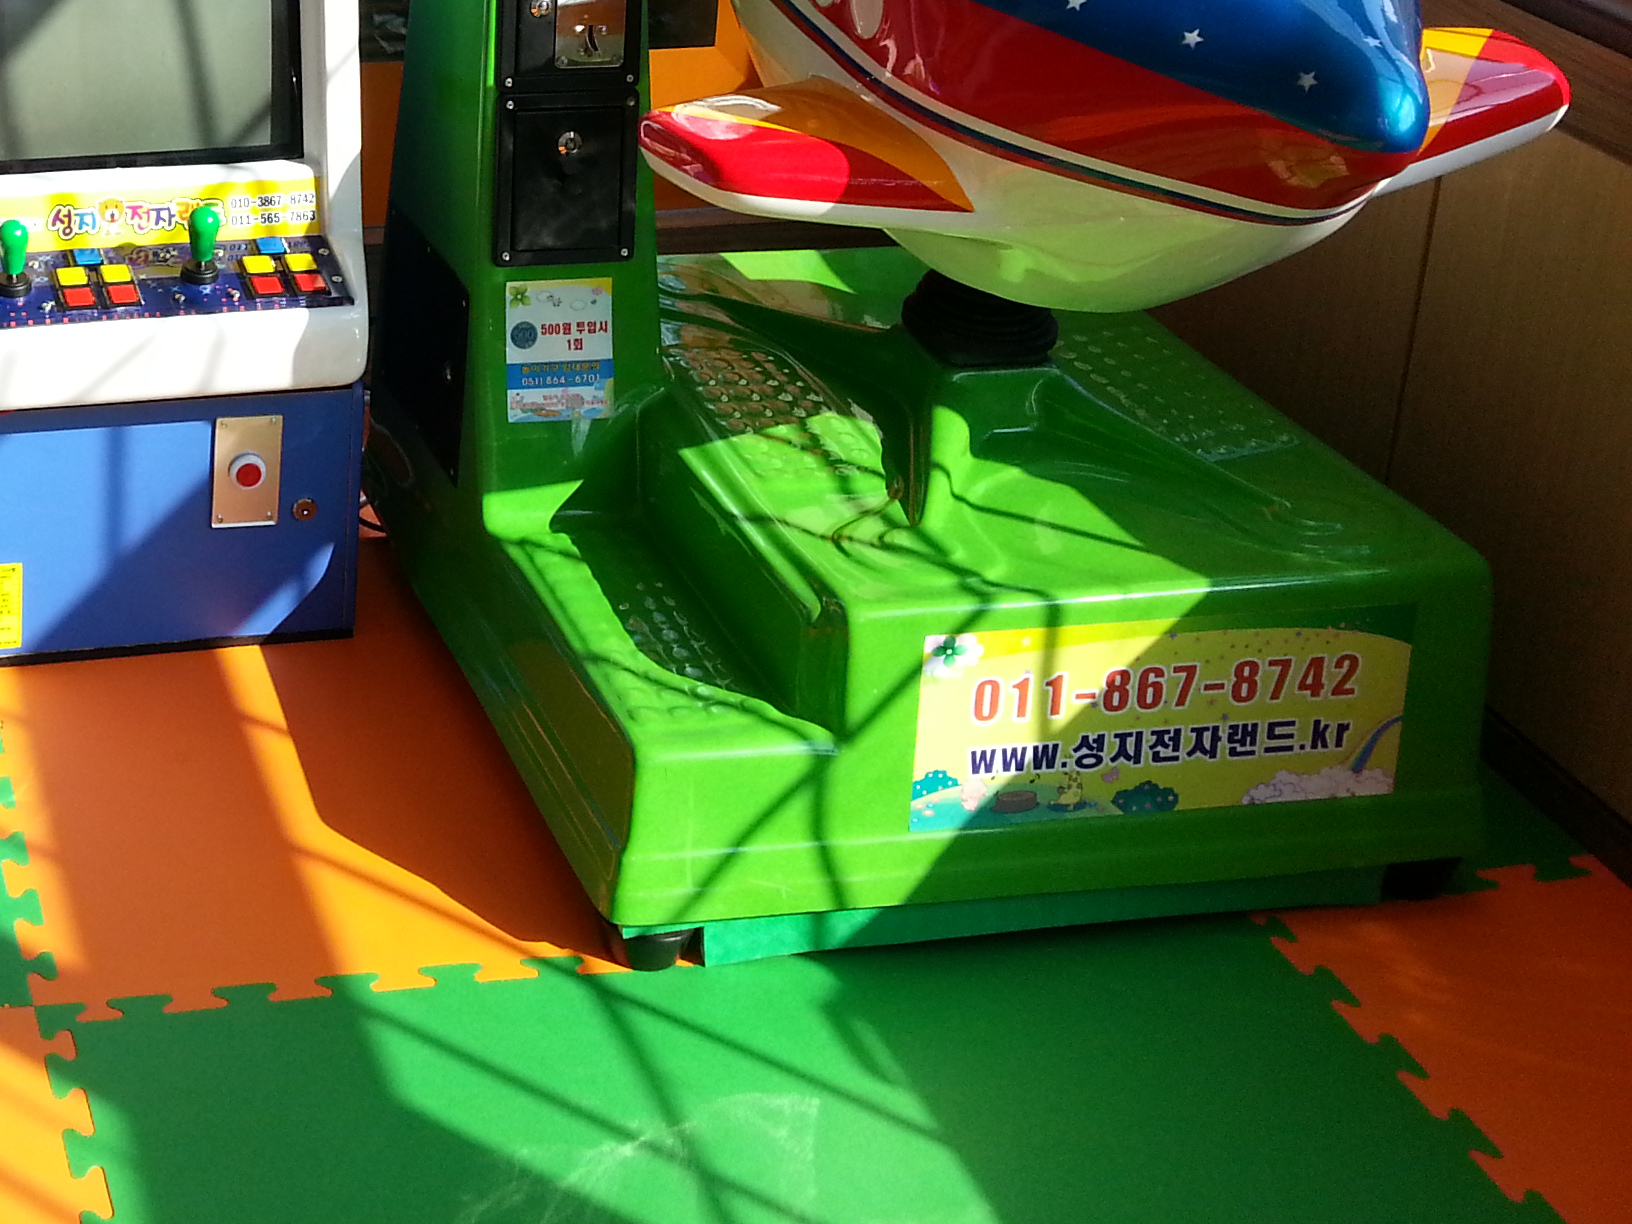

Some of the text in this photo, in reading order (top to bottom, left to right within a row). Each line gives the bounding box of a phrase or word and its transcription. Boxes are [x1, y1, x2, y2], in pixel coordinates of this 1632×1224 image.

[52, 207, 96, 237] 성지
[540, 320, 608, 336] 500원 투입시
[566, 337, 584, 351] 1회
[971, 652, 1361, 723] 011-867-8742
[970, 718, 1351, 775] www.성지전자랜드.kr
